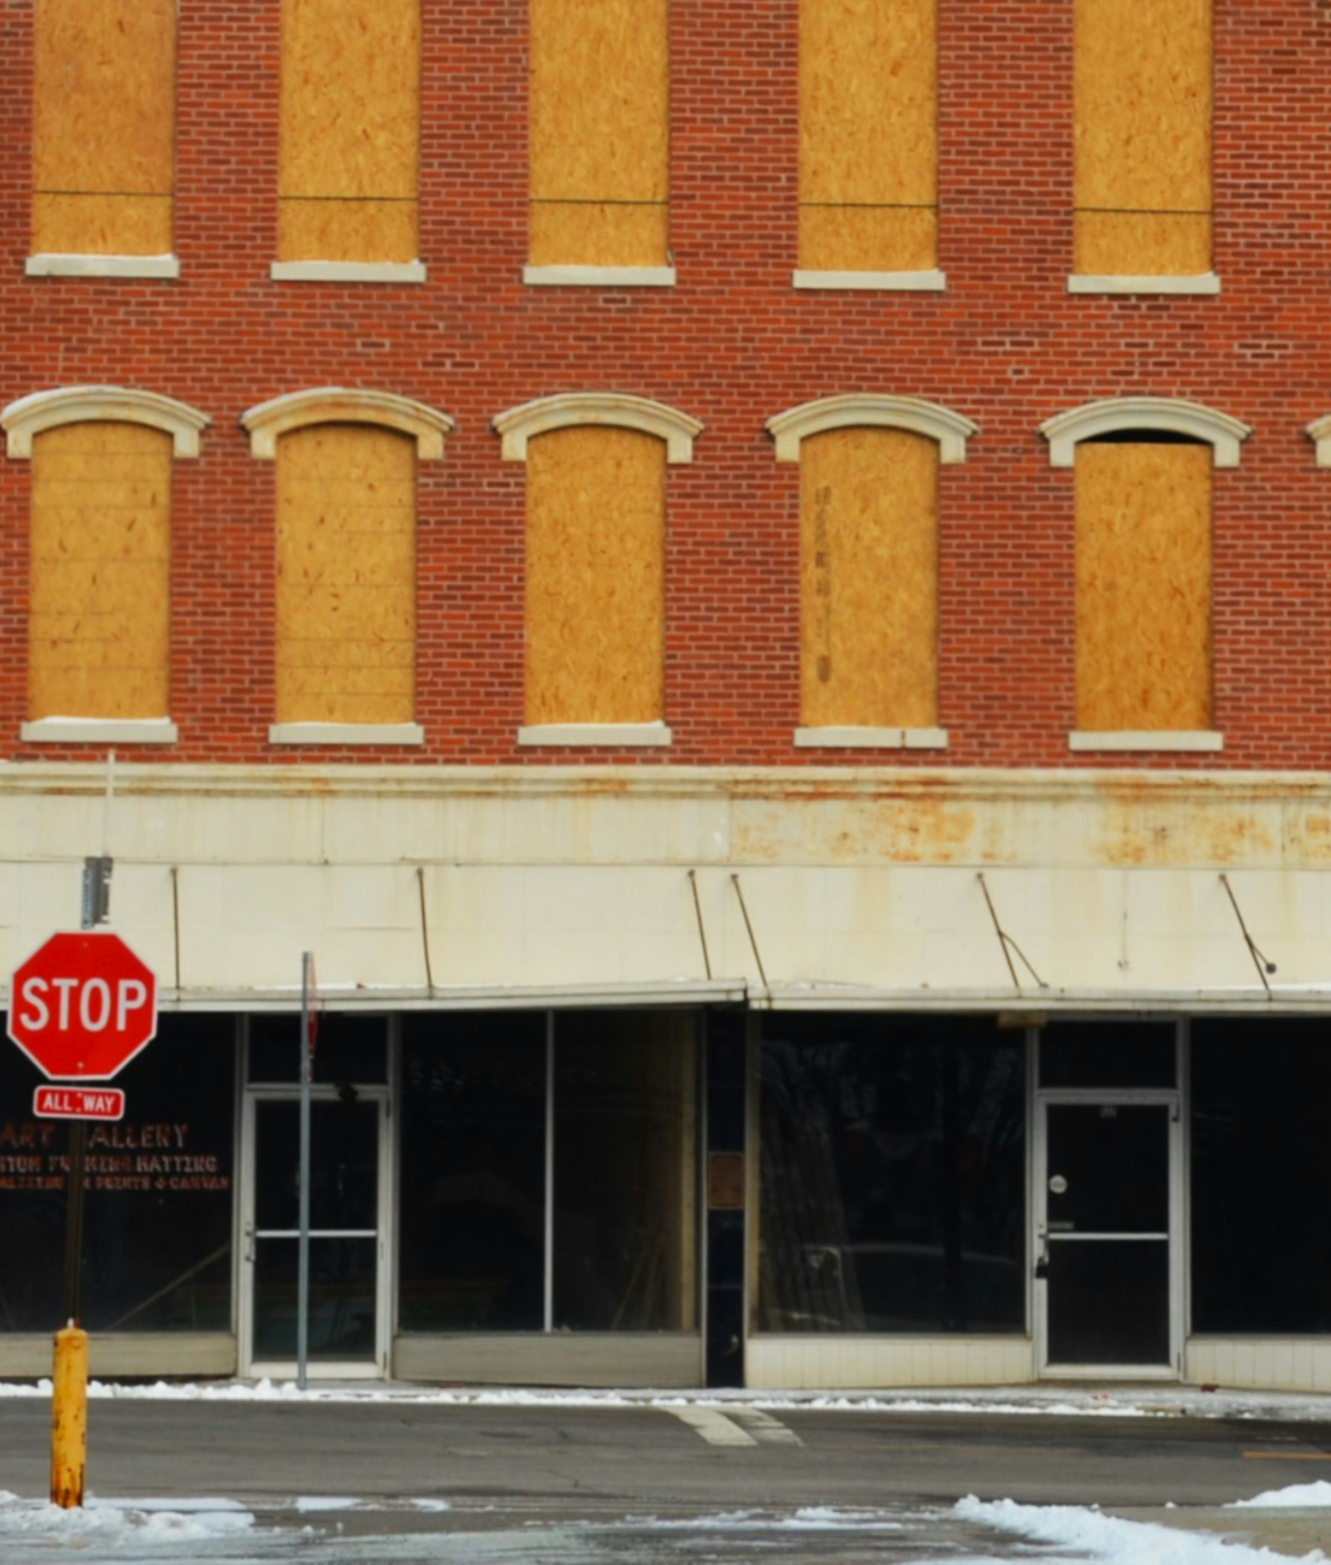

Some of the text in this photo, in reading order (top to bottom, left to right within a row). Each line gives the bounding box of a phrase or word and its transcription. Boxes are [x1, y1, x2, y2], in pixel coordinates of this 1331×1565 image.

[20, 977, 147, 1032] STOP
[42, 1093, 116, 1113] ALL WAY
[81, 1122, 189, 1149] ALLERY
[48, 1154, 133, 1173] FRMING
